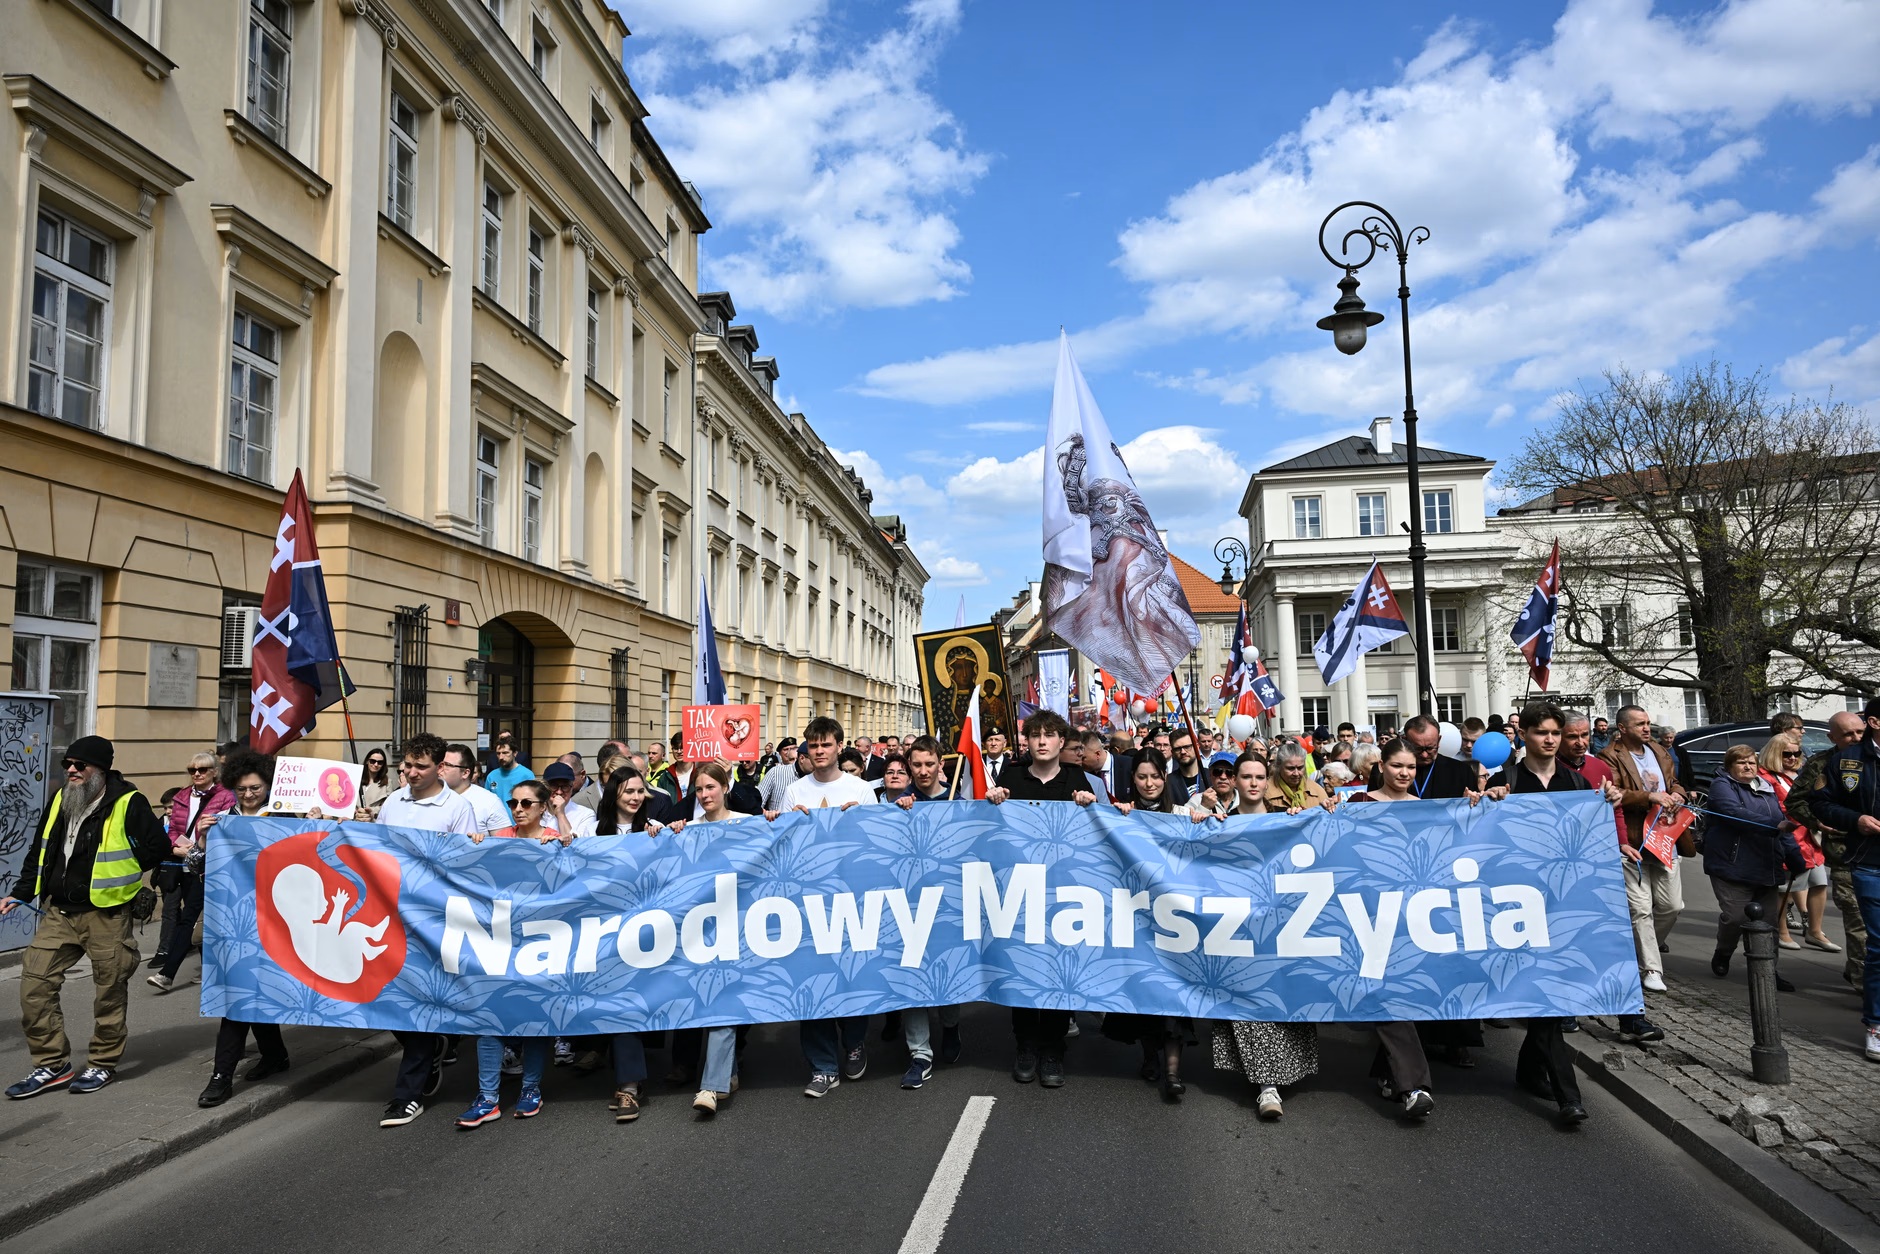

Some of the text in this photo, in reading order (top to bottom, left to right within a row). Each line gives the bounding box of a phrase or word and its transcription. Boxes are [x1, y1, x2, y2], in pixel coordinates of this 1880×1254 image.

[687, 709, 716, 729] TAK
[694, 729, 713, 740] dla
[687, 739, 722, 758] ŻYCIA
[276, 774, 297, 785] jest
[274, 787, 316, 798] darem!
[1645, 824, 1657, 849] TAK
[1660, 834, 1674, 866] ŻYCIA
[440, 843, 1551, 980] Narodowy Marsz Życia
